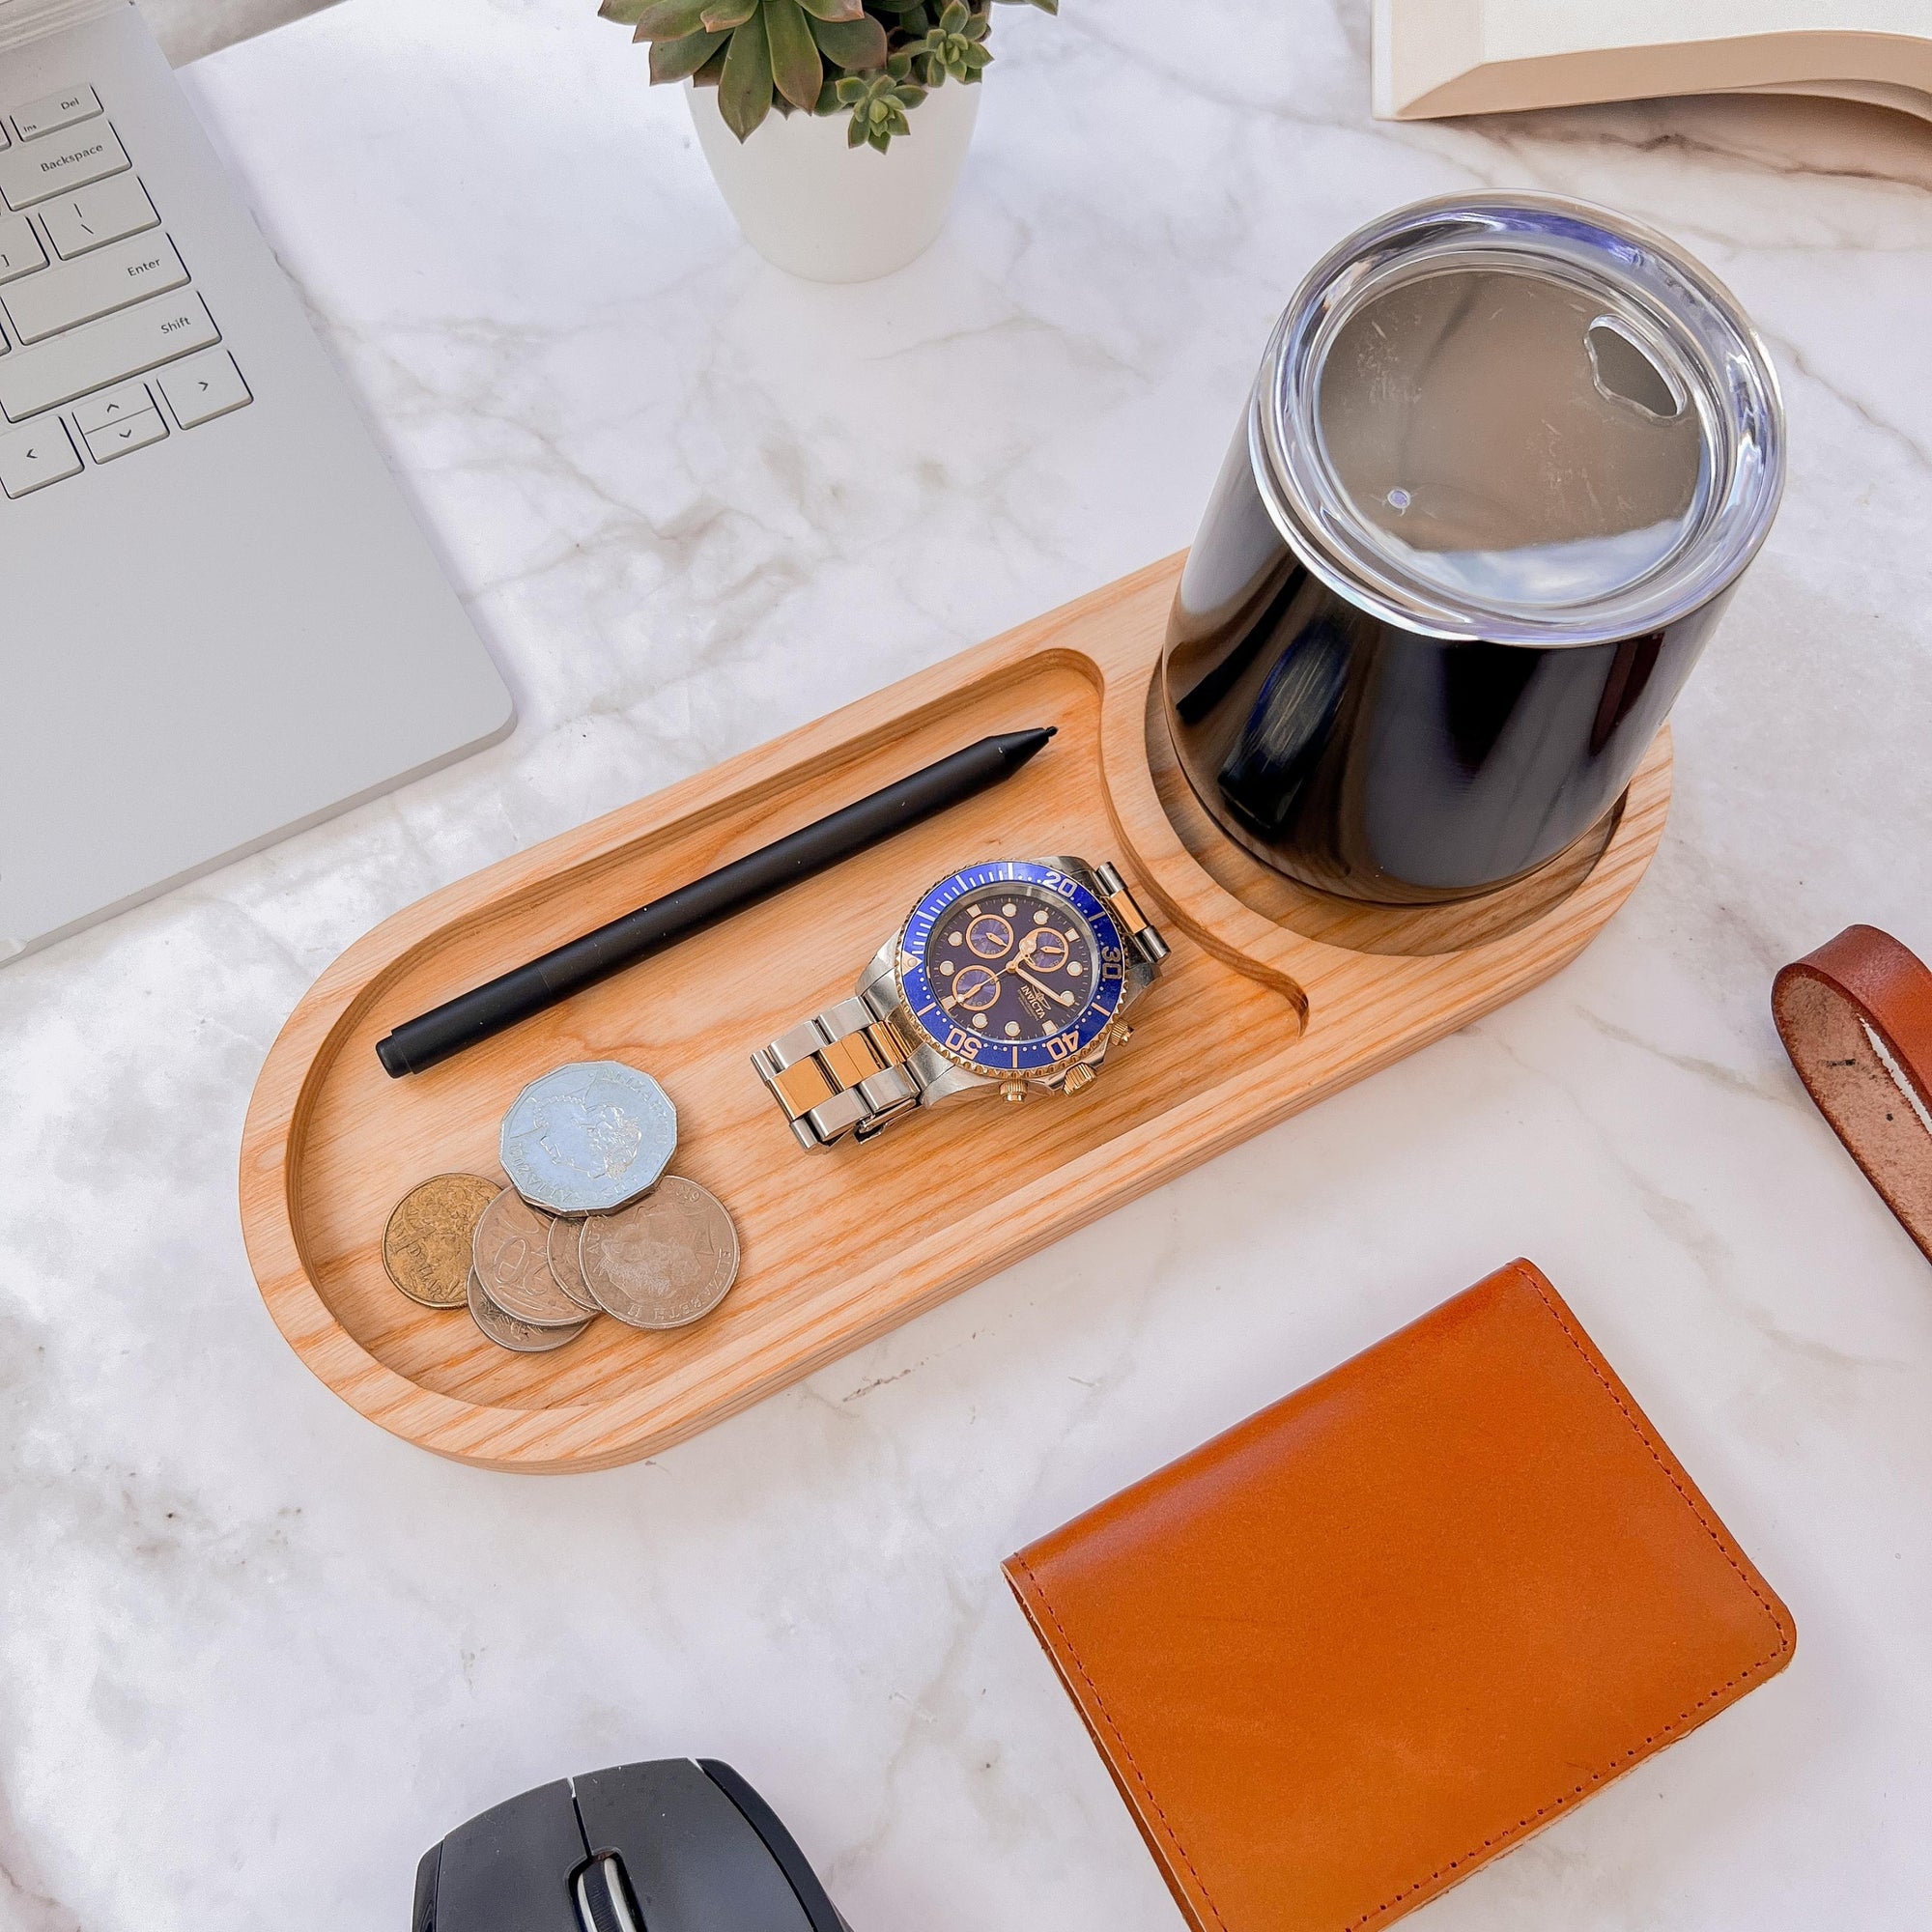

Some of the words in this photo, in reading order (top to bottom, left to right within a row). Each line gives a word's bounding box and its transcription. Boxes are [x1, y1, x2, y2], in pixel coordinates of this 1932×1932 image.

[61, 98, 79, 110] Del
[23, 124, 37, 132] Ins
[41, 144, 103, 172] Backspace
[127, 258, 161, 277] Enter
[160, 317, 191, 334] Shift
[1043, 871, 1077, 897] 20
[1101, 947, 1122, 980] 30
[1020, 985, 1045, 1019] INVICTA
[945, 1028, 982, 1060] 50
[1046, 1030, 1080, 1061] 40
[654, 1248, 731, 1321] ELIZABETH
